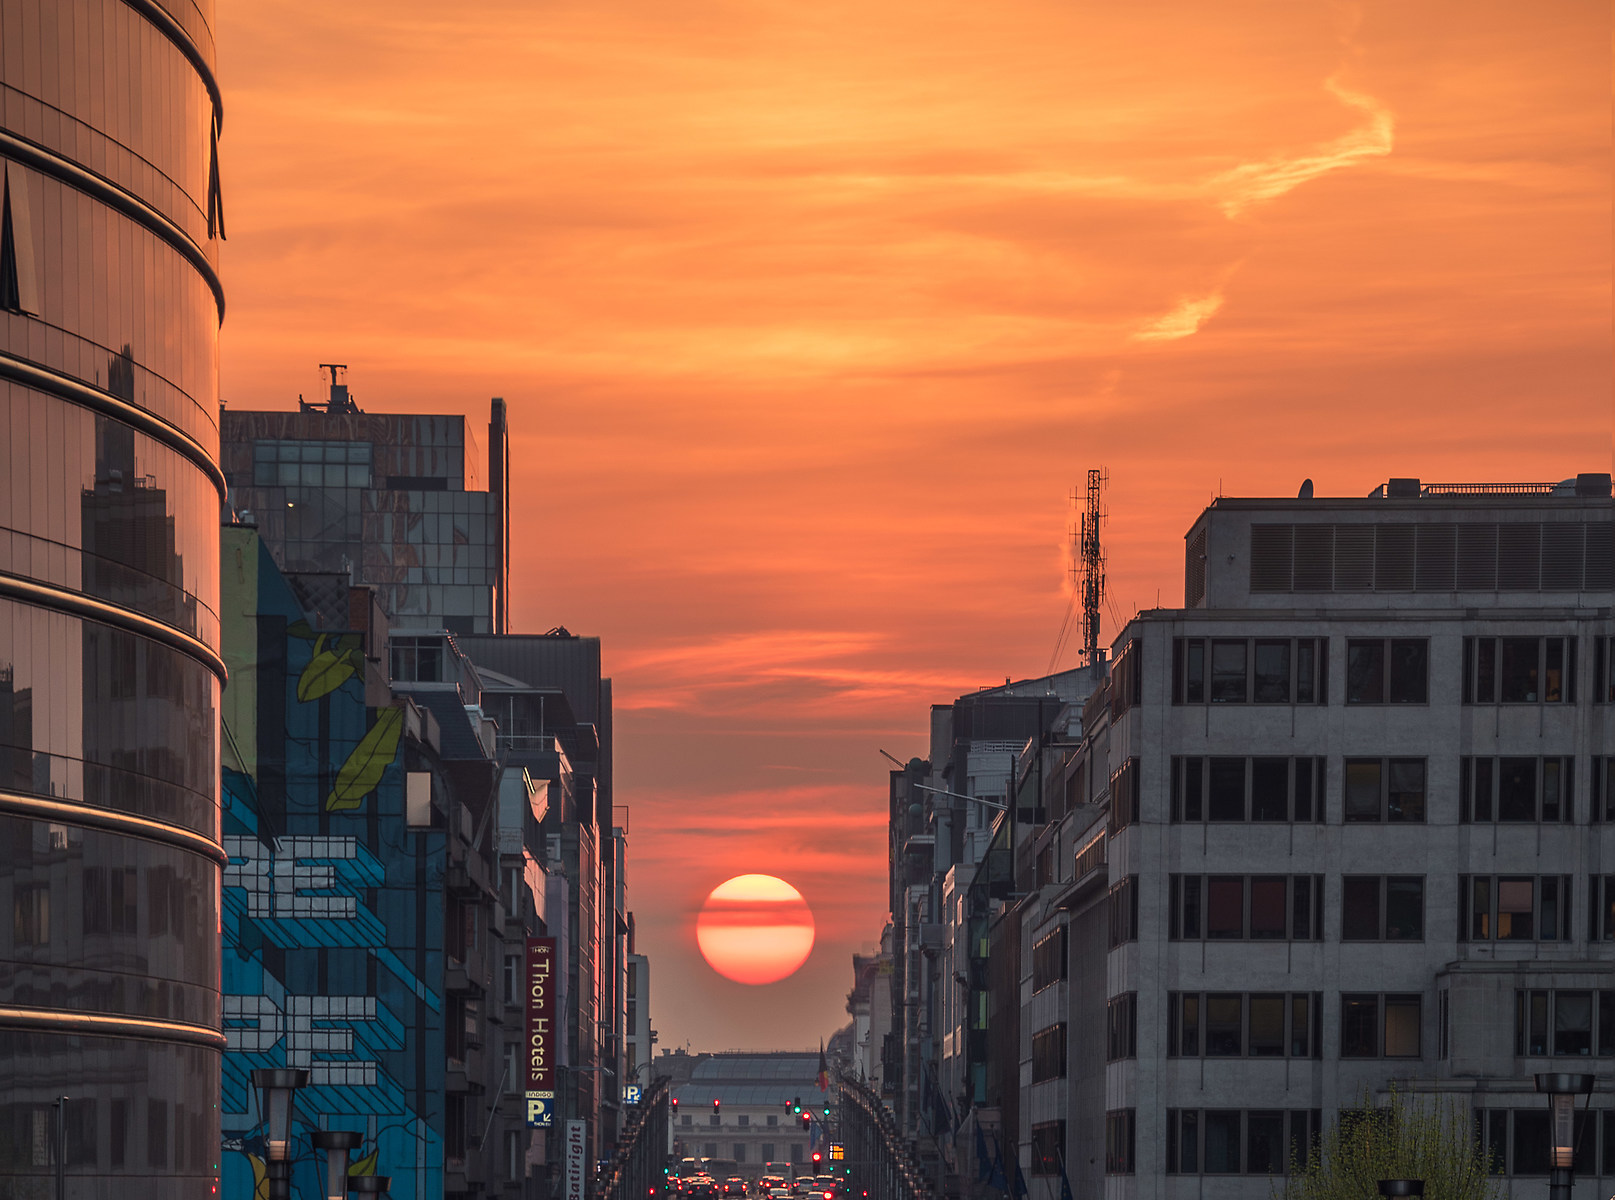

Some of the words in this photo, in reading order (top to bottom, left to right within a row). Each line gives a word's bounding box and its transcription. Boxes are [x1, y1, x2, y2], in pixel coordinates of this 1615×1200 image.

[532, 958, 549, 1009] Thon
[531, 1018, 549, 1081] Hotels
[528, 1100, 545, 1121] P
